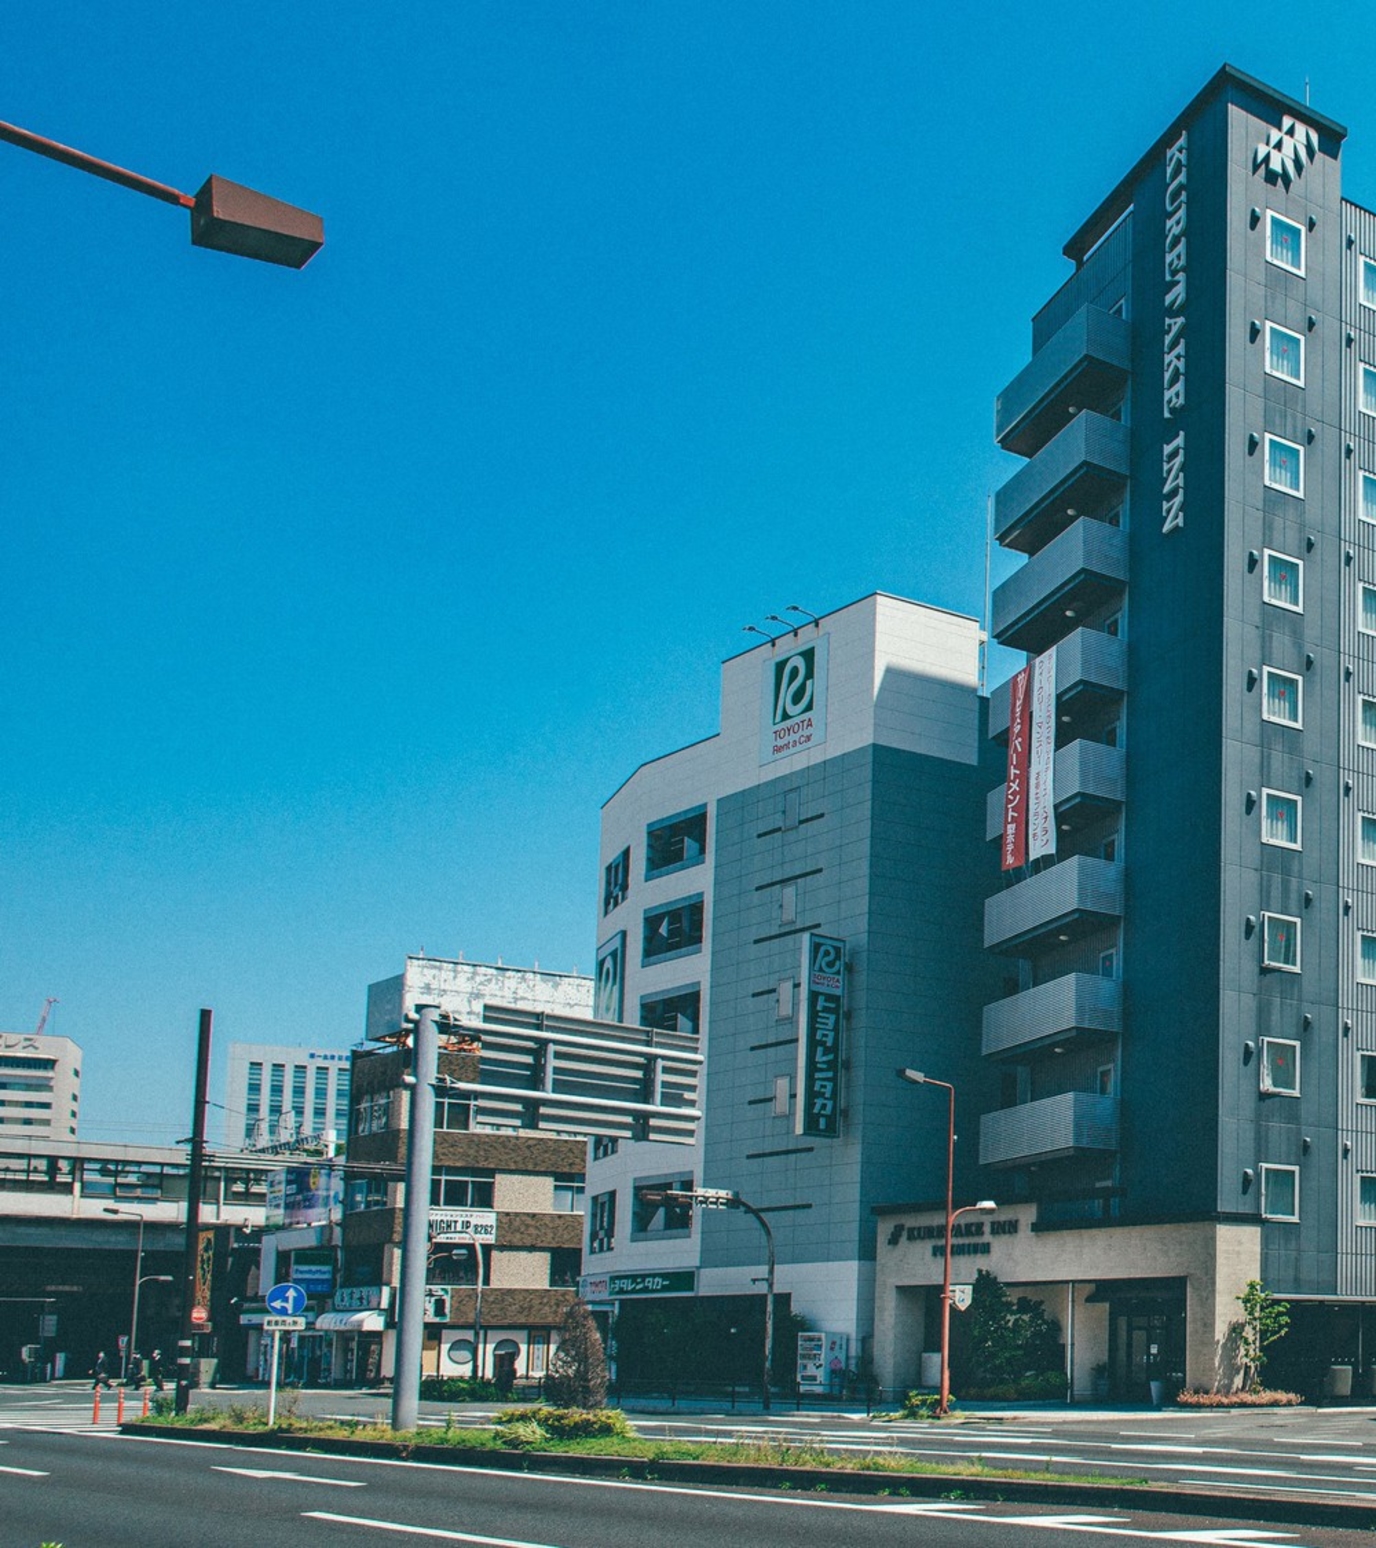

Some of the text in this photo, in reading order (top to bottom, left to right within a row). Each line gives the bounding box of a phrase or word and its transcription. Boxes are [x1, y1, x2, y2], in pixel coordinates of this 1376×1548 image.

[1162, 129, 1188, 534] KURETAKE INN
[772, 717, 813, 742] TOYOTA
[772, 732, 813, 755] Rent a Car
[814, 974, 840, 984] TOYOTA
[812, 995, 836, 1130] トヨタレンタカー
[473, 1223, 495, 1235] 8262
[907, 1219, 1019, 1240] KUREAKE INN
[610, 1276, 670, 1292] トヨタレンタカー
